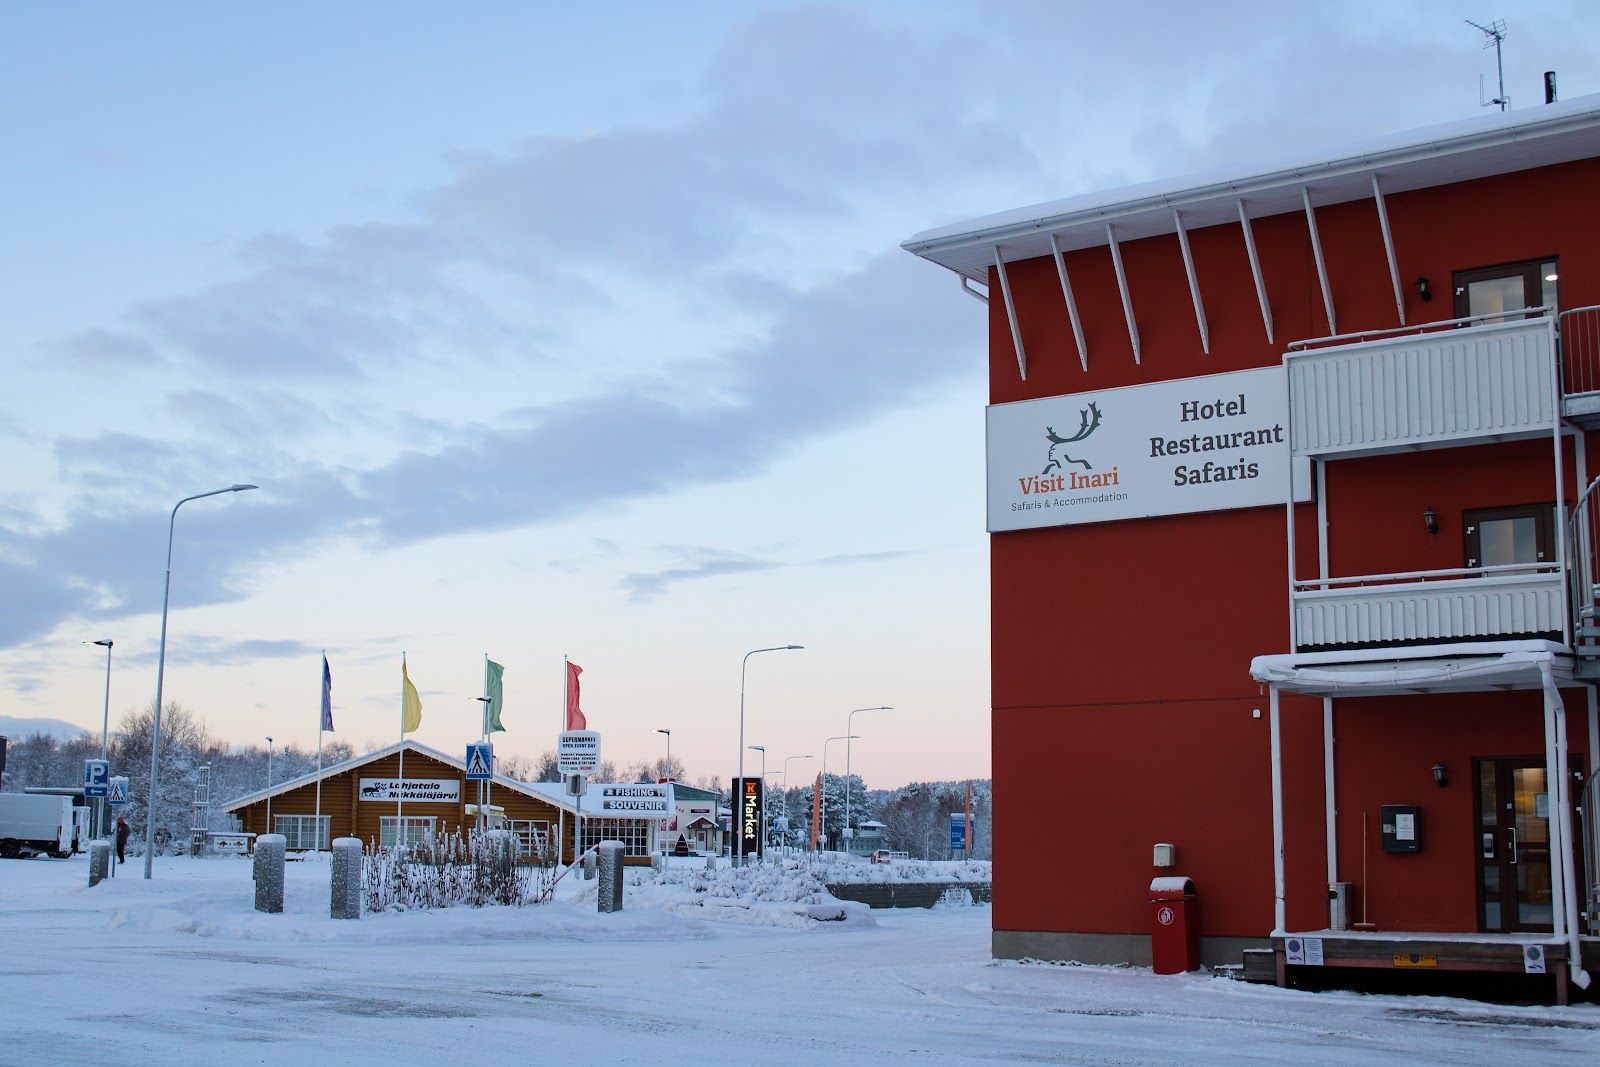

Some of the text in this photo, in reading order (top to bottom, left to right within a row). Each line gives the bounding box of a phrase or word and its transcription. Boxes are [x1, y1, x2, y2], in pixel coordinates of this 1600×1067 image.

[1180, 394, 1246, 422] Hotel
[1150, 424, 1283, 457] Restaurant
[1019, 466, 1119, 494] Visit Inari
[1174, 458, 1258, 486] Safaris
[1011, 492, 1128, 512] Safaris & Accommodation
[90, 764, 105, 785] P
[609, 800, 663, 810] SOUVENIR
[615, 788, 655, 797] FISHING
[745, 795, 757, 839] Market
